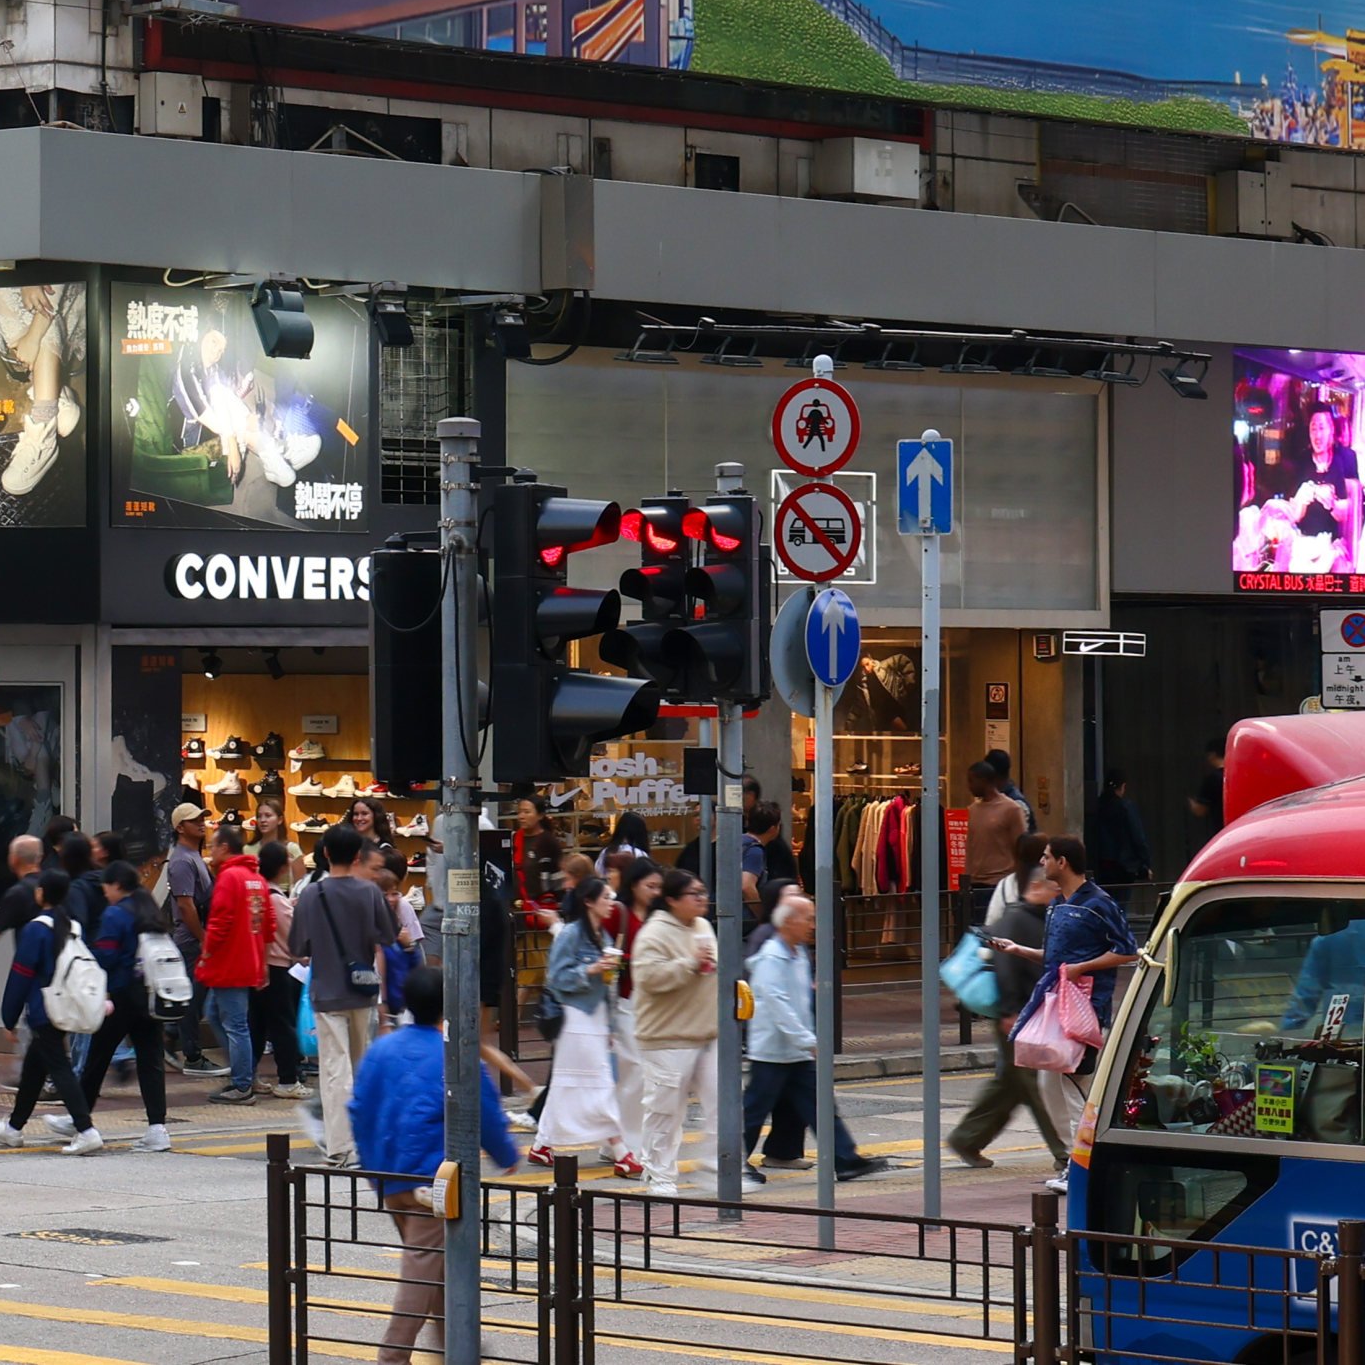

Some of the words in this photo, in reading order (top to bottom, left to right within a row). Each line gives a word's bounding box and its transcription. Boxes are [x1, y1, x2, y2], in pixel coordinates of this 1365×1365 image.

[1239, 574, 1282, 591] CRYSTAL
[1283, 575, 1305, 591] BUS
[1305, 575, 1344, 592] 水晶巴士
[1334, 664, 1356, 675] 上午
[1326, 684, 1364, 694] midnight
[1334, 695, 1355, 705] 午夜
